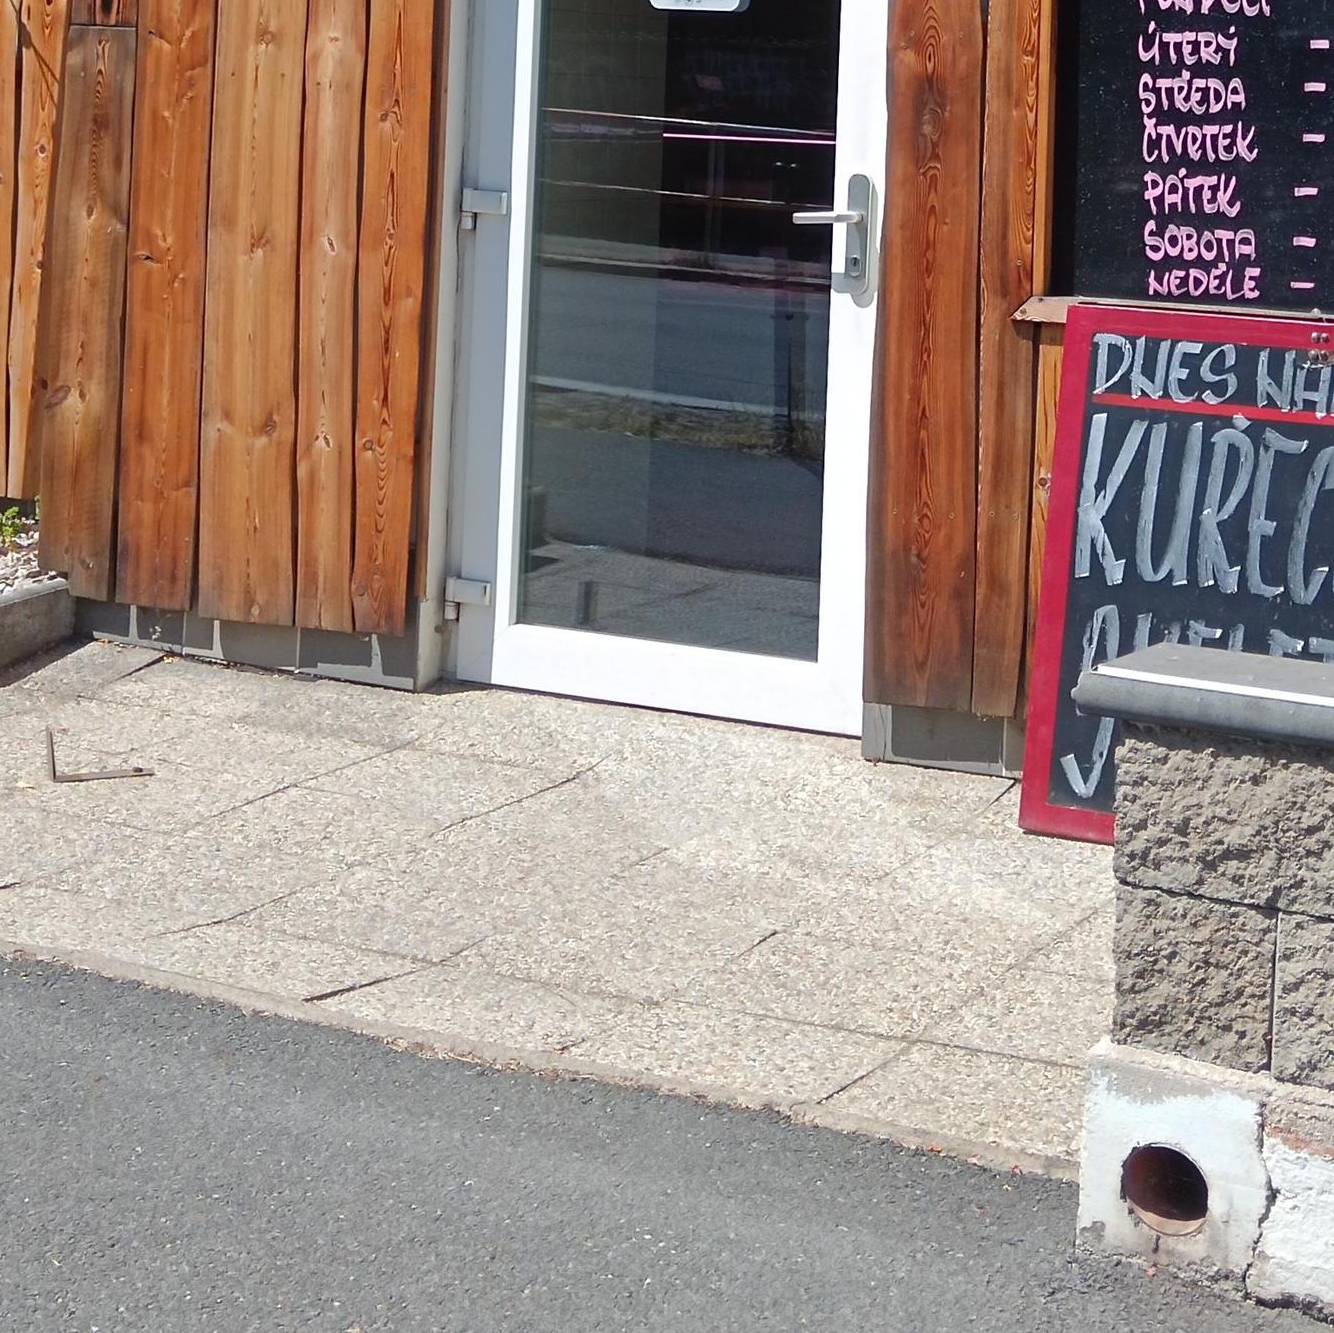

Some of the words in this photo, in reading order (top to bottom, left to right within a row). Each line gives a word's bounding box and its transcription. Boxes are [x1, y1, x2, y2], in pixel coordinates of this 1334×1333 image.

[1138, 20, 1238, 66] ÚTERÝ
[1138, 69, 1246, 115] STŘEDA
[1142, 115, 1259, 163] ČTVRTEK
[1143, 167, 1241, 217] PÁTEK
[1143, 220, 1256, 262] SOBOTA
[1148, 263, 1261, 301] NEDĚLE
[1091, 333, 1238, 405] DNES
